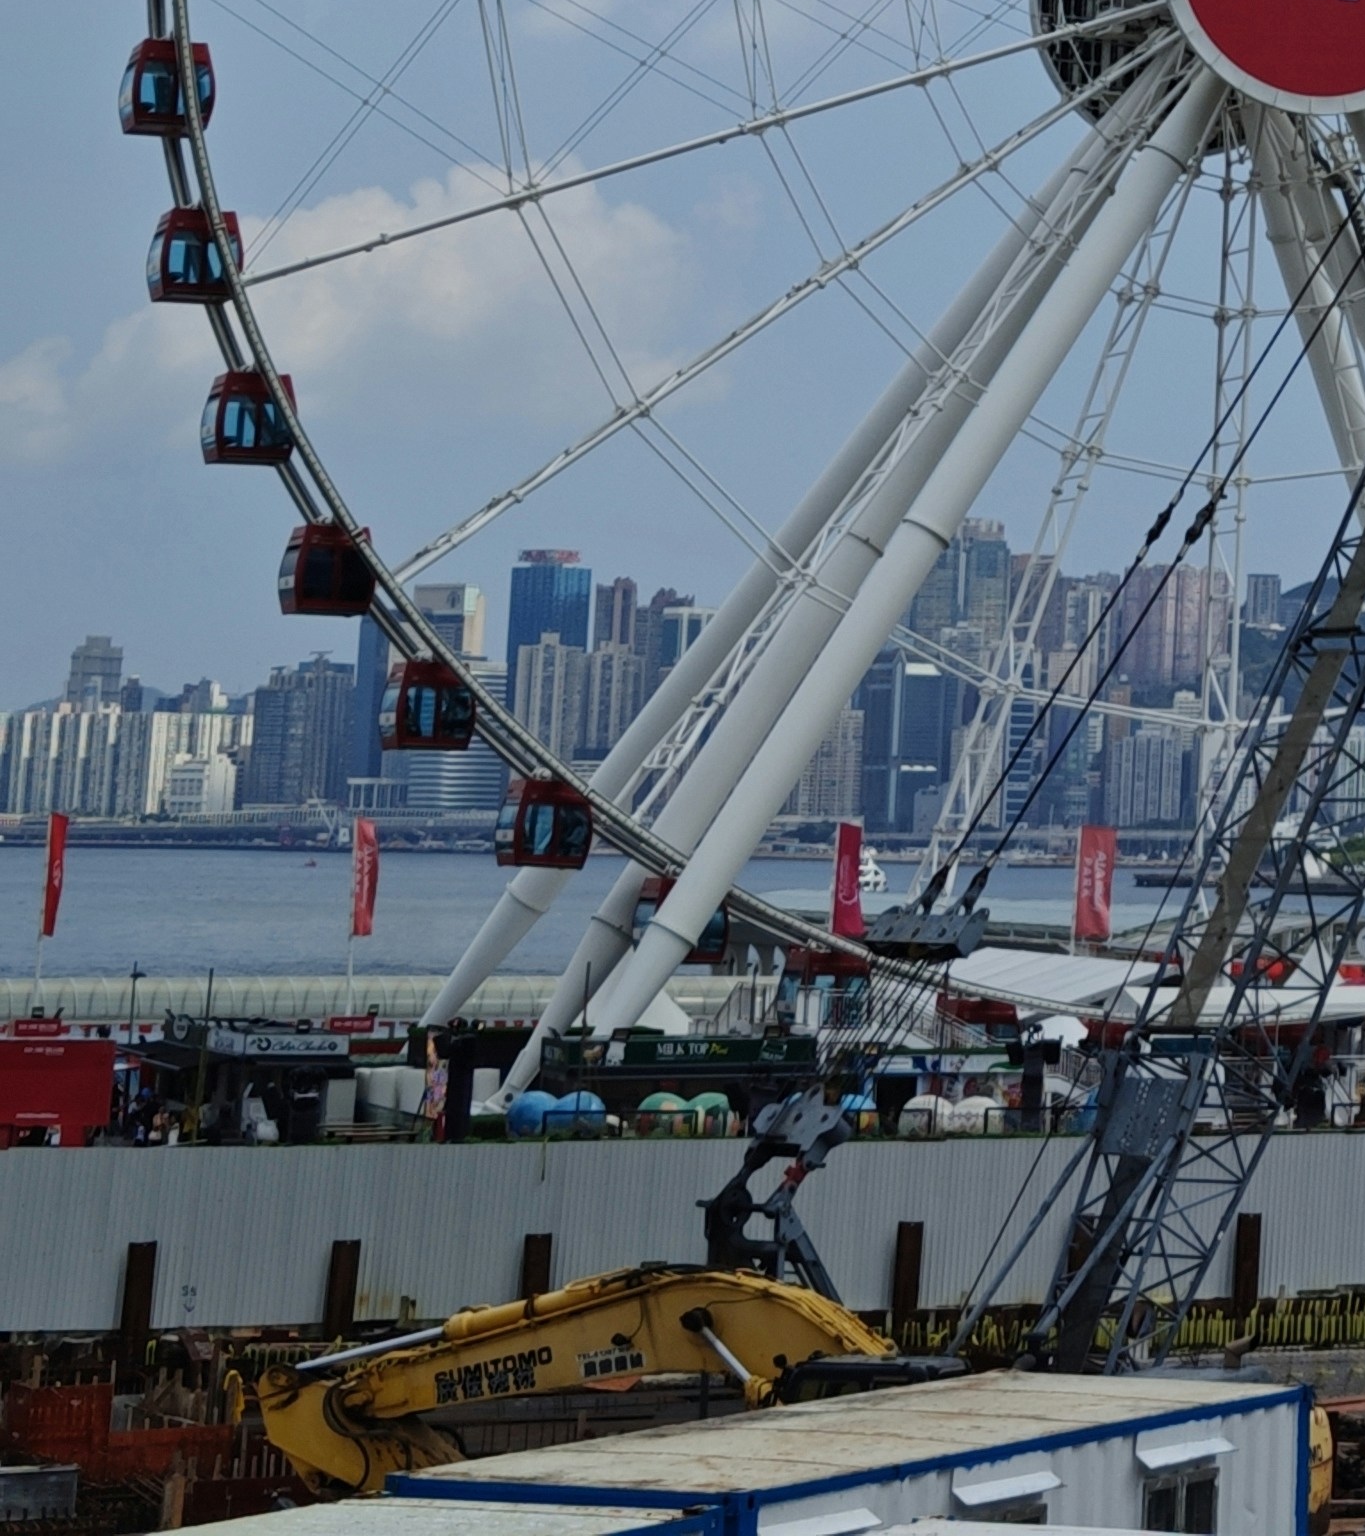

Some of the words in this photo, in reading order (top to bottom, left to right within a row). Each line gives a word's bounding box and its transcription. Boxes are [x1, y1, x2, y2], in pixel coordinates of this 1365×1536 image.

[656, 1042, 685, 1054] MILK
[688, 1041, 709, 1055] TOP
[434, 1346, 553, 1386] SUMITOMO
